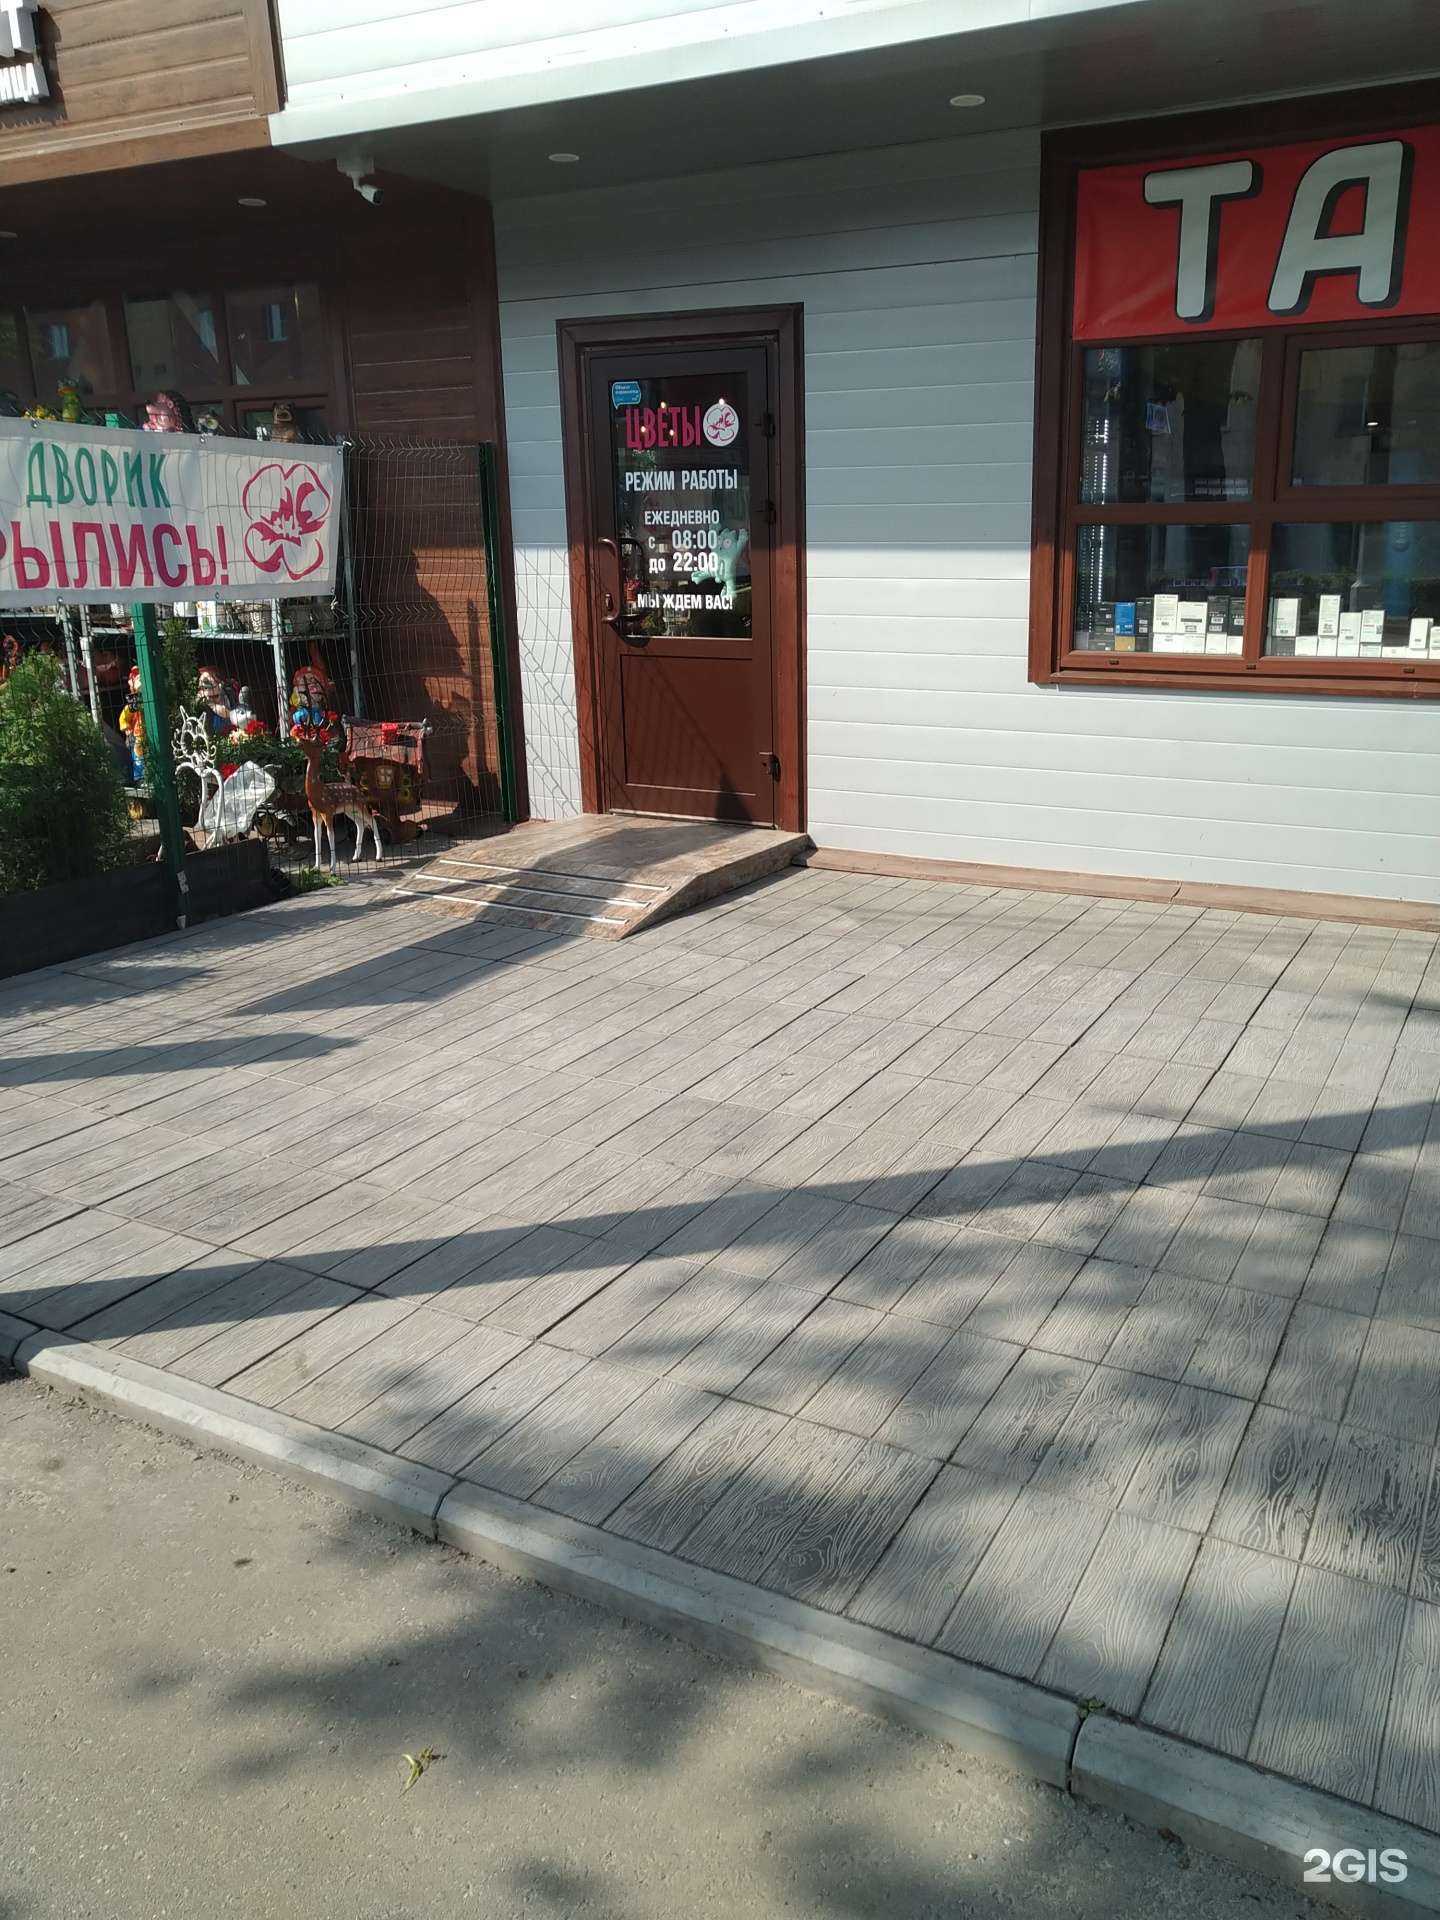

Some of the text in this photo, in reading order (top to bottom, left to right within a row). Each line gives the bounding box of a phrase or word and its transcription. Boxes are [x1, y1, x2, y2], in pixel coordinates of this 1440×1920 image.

[625, 406, 701, 449] ЦВЕТЫ
[26, 441, 172, 508] ДВОРИК
[625, 469, 738, 492] РЕЖИМ РАБОТЫ
[644, 510, 720, 527] ЕЖЕДНЕВНО
[671, 530, 718, 549] 08:00
[0, 521, 230, 590] ЫЛИСЬ!
[649, 552, 719, 574] до 22:00
[637, 594, 733, 611] МЫ ЖДЕМ ВАС!
